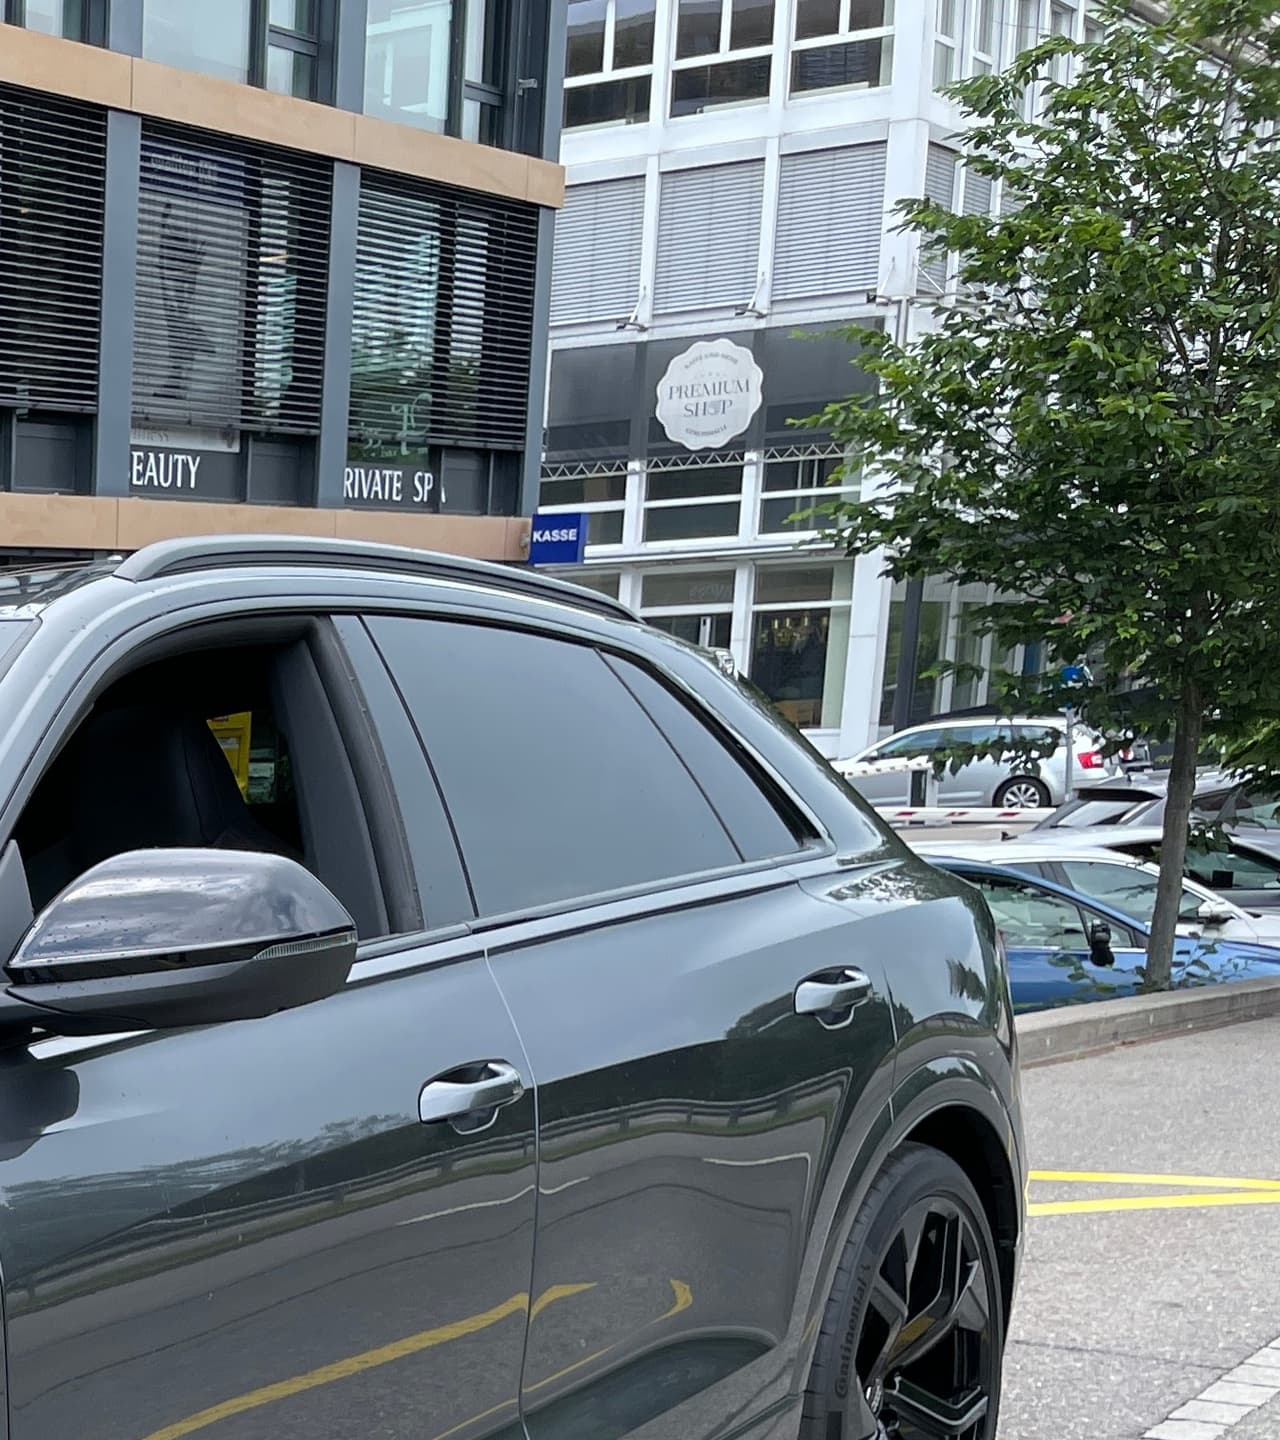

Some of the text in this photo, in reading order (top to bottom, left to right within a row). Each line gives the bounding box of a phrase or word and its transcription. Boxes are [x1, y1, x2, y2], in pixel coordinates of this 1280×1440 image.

[668, 379, 749, 400] PREMIUM
[128, 450, 201, 489] EAUTY
[532, 528, 578, 543] KASSE
[834, 1276, 868, 1400] Continental
